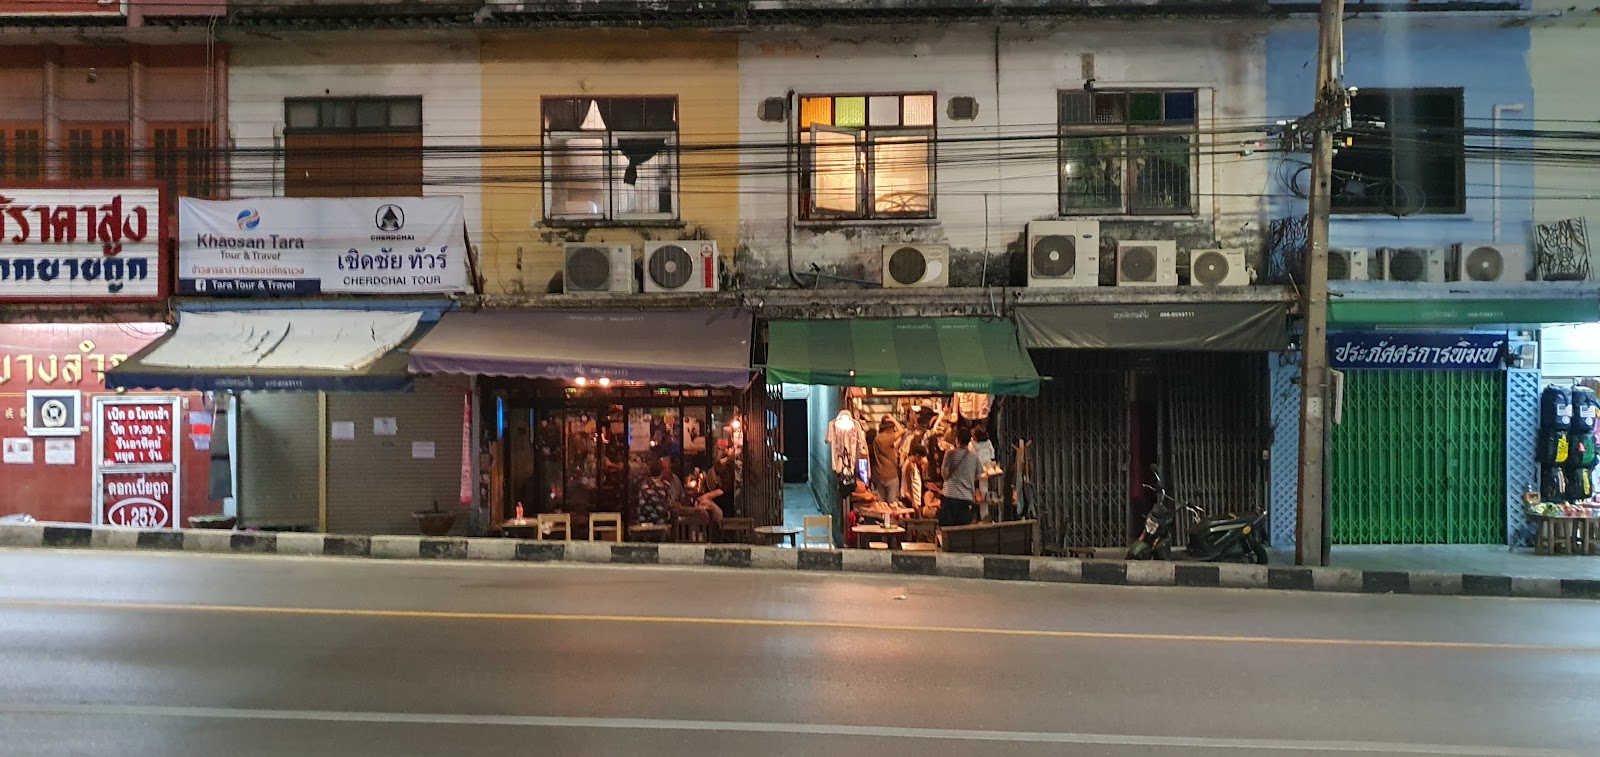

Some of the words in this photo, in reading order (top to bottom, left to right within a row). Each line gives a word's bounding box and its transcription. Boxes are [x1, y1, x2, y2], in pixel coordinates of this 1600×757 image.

[0, 193, 148, 256] ราคาสูง
[197, 233, 265, 249] Khaosan
[269, 234, 304, 249] Tara
[220, 250, 241, 260] Tour
[243, 250, 250, 260] &
[252, 250, 281, 260] Travel
[338, 247, 403, 270] เชิดชัย
[408, 245, 448, 270] ทัวร์
[212, 280, 233, 290] Tara
[234, 280, 256, 290] Tour
[257, 280, 265, 290] &
[266, 280, 296, 291] Travel
[343, 275, 406, 285] CHERDCHAI
[411, 275, 441, 285] TOUR
